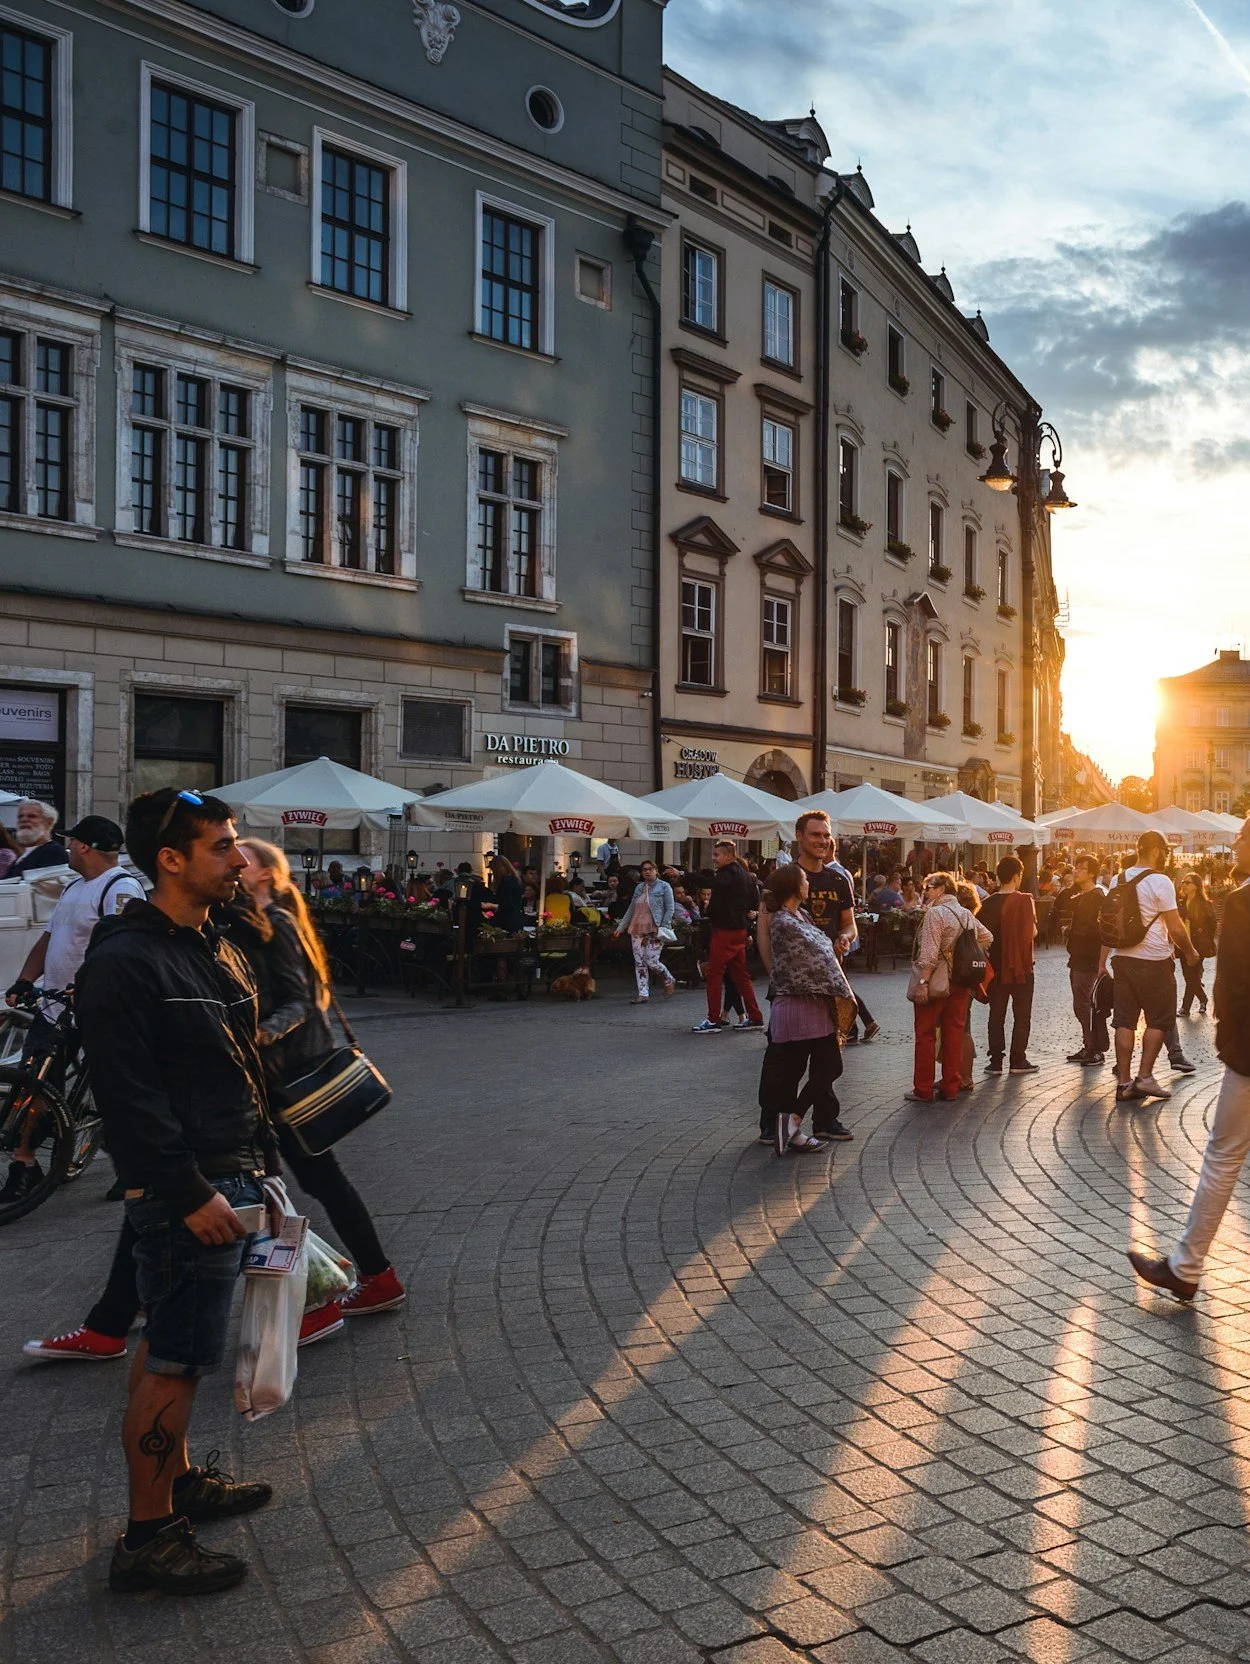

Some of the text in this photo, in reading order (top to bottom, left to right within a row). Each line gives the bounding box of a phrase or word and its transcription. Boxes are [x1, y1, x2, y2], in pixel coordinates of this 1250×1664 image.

[0, 707, 52, 718] uvenirs
[487, 734, 570, 755] DA PIETRO
[498, 755, 559, 765] restauraa
[681, 747, 718, 761] CRACOW
